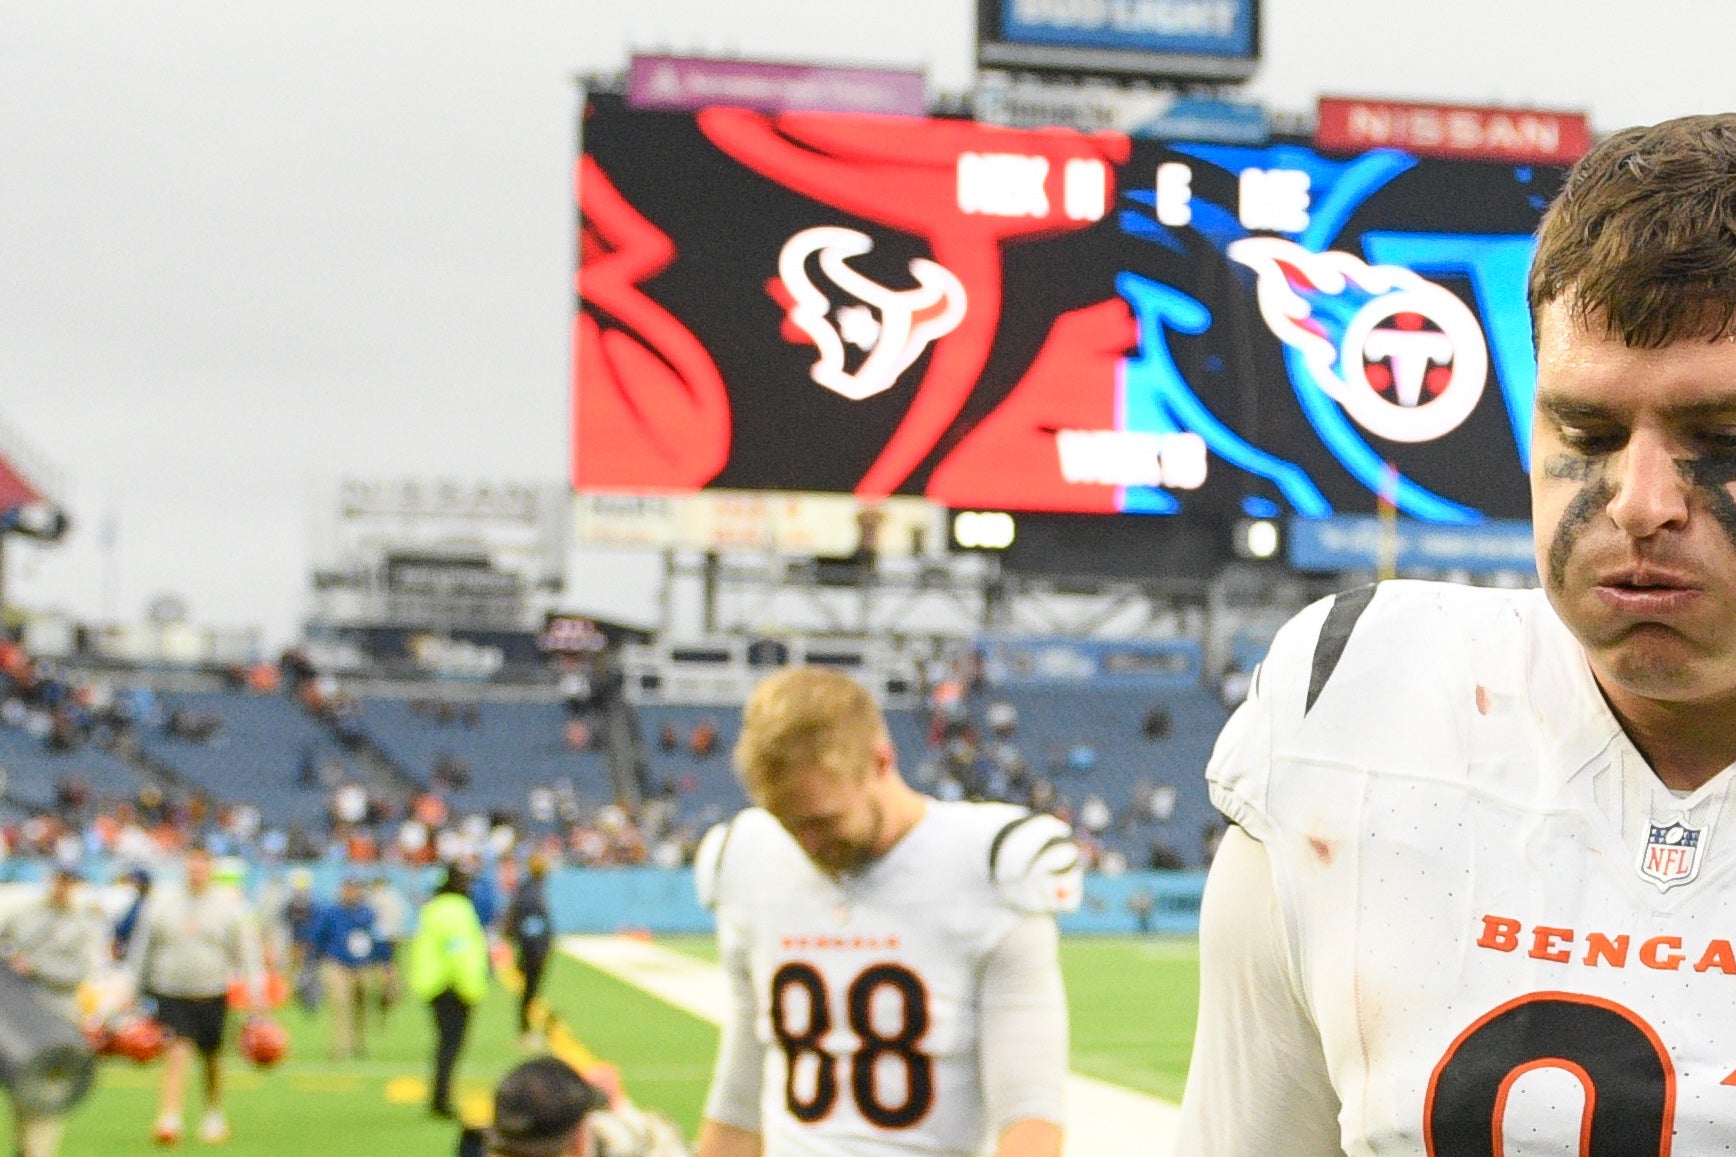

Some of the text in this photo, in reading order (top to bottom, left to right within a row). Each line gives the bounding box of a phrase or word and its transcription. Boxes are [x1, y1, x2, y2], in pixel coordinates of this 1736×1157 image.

[1348, 105, 1560, 153] NISSAN
[1646, 846, 1689, 877] NFL
[770, 959, 936, 1131] 88
